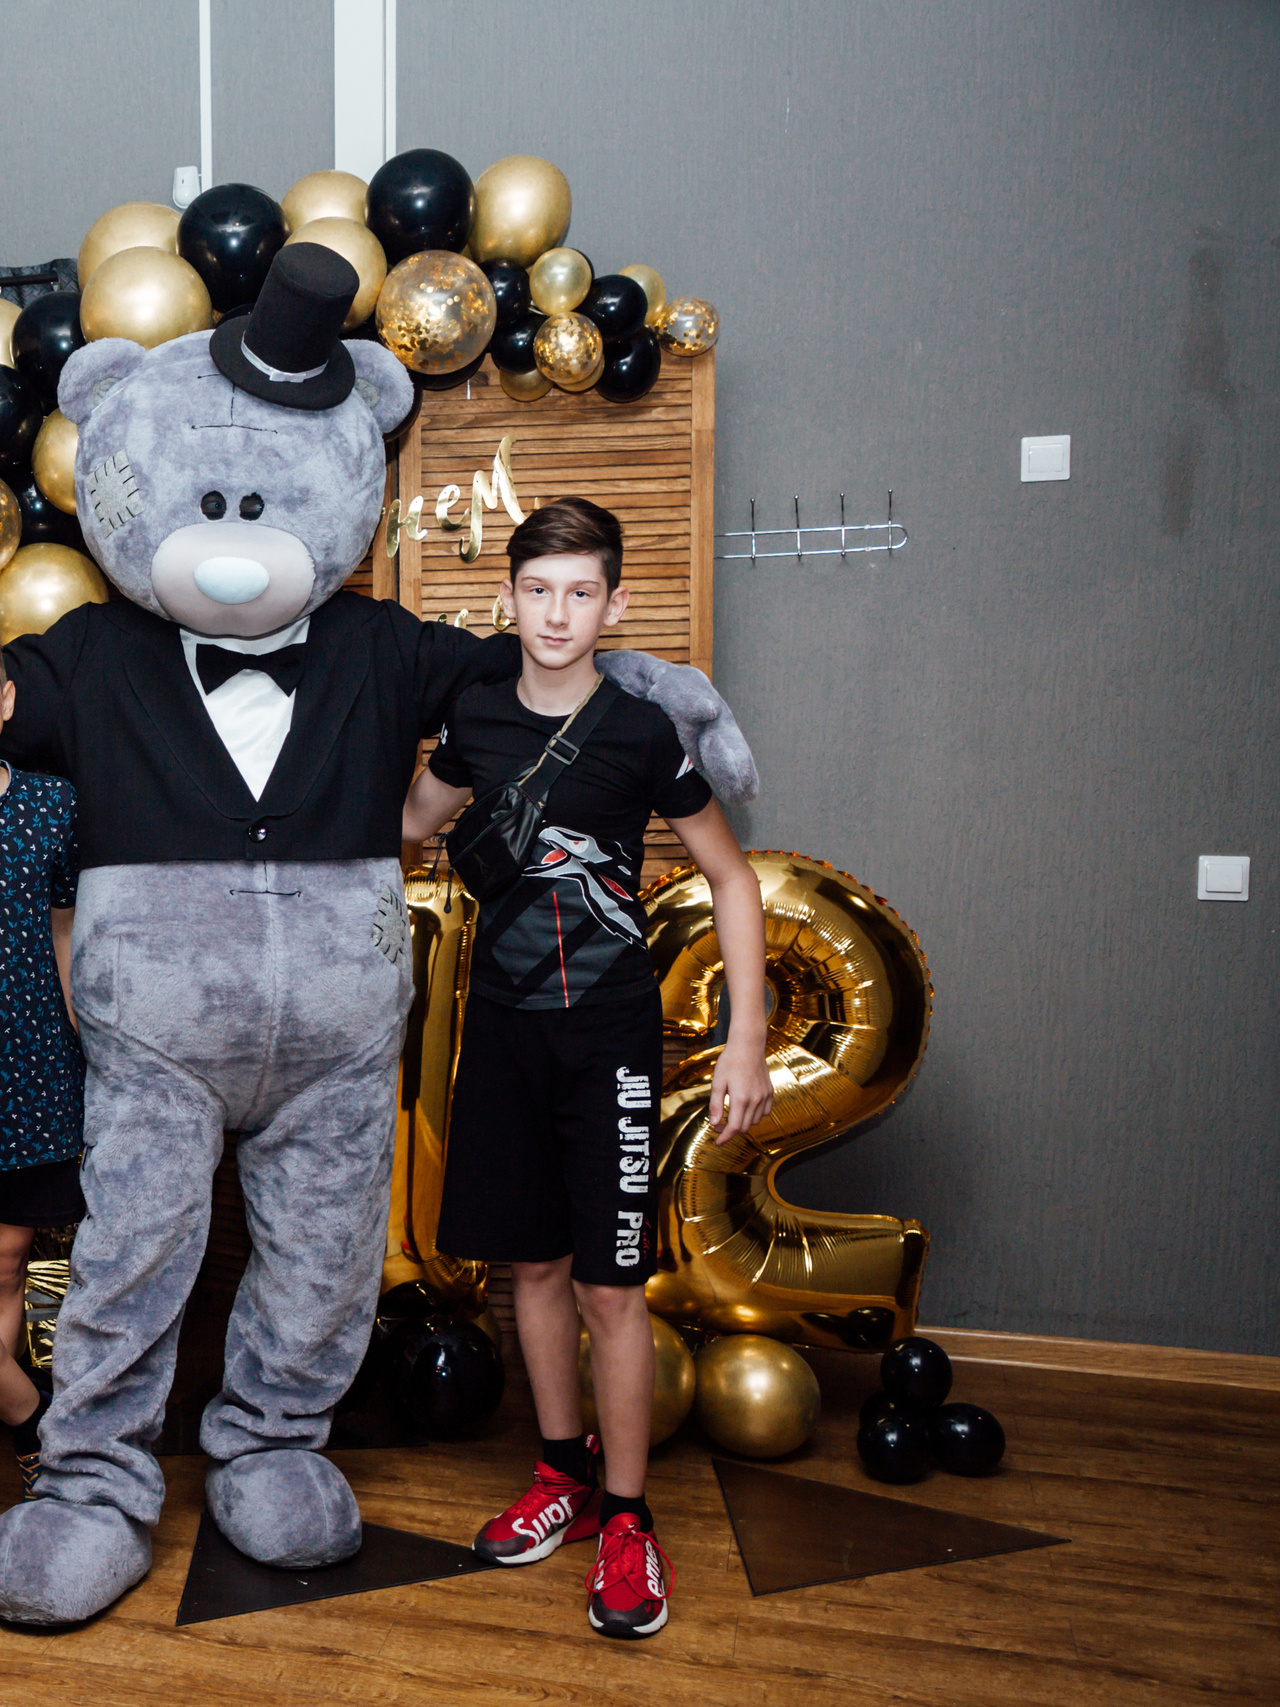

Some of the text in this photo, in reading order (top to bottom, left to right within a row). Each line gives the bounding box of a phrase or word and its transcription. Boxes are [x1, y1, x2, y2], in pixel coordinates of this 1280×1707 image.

[615, 1066, 652, 1267] JIU JITSU PRO
